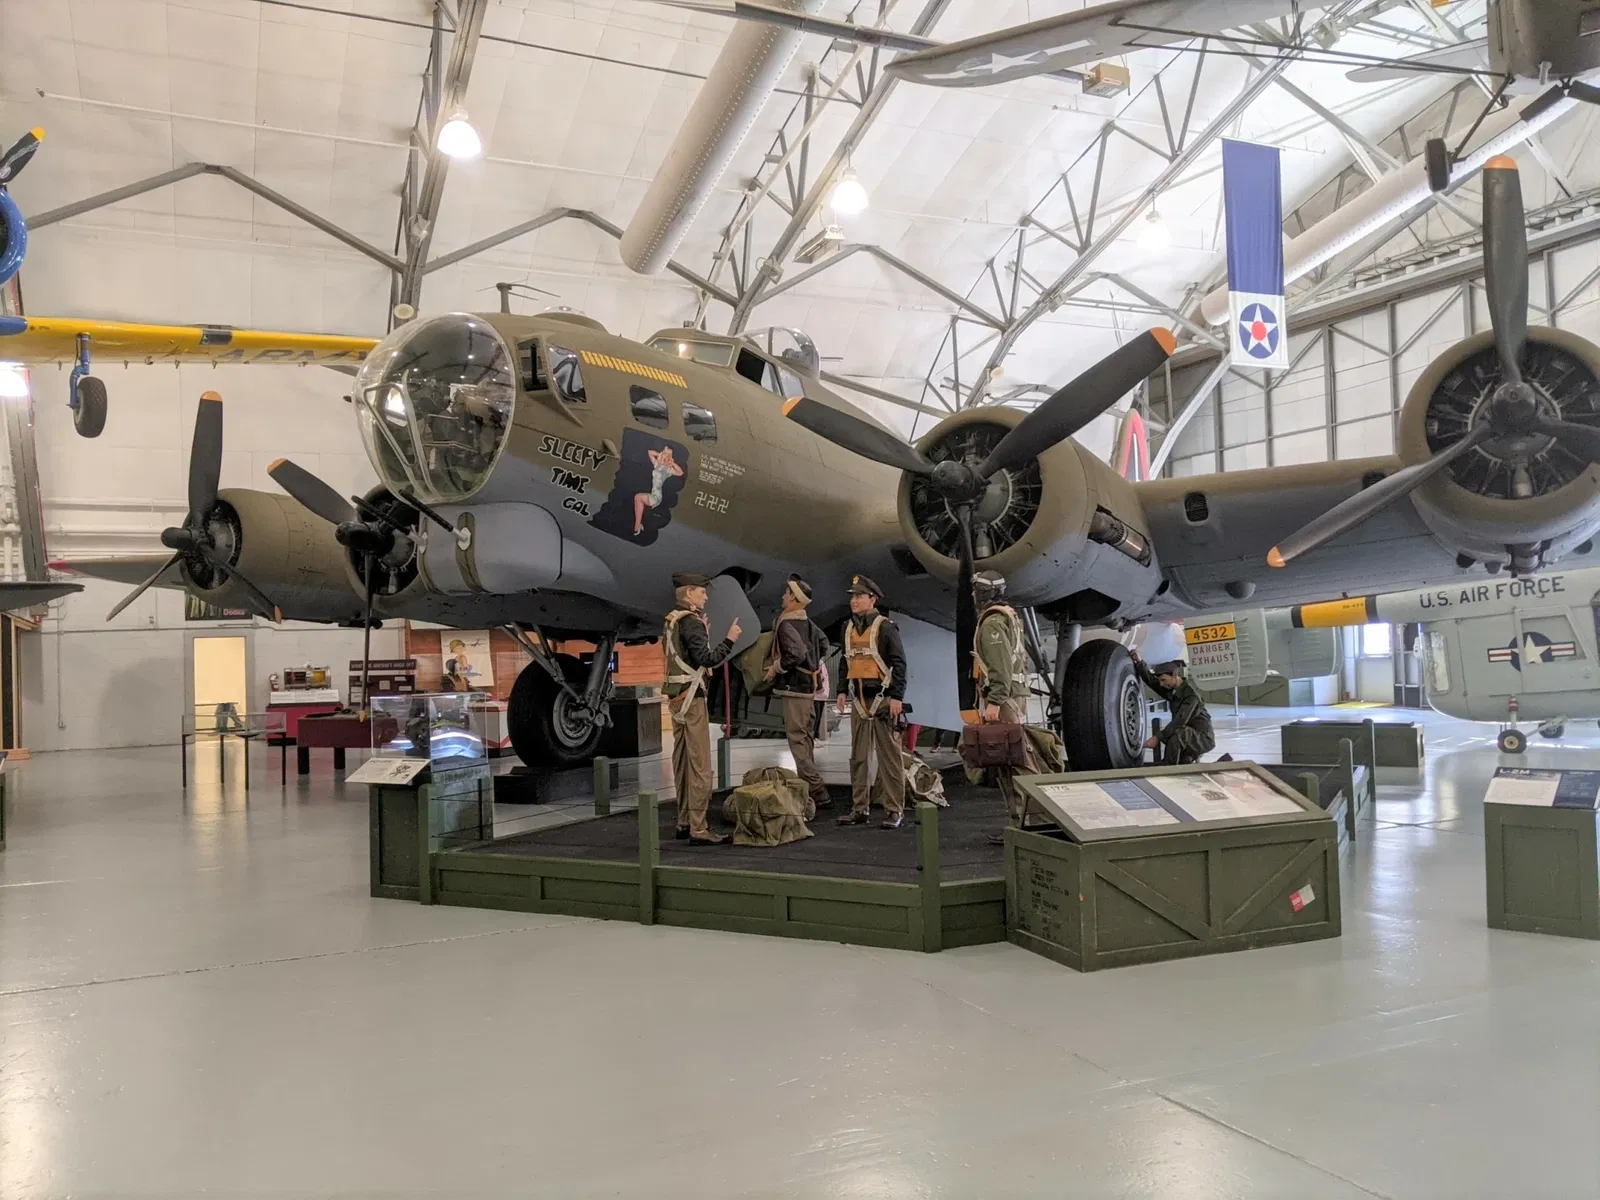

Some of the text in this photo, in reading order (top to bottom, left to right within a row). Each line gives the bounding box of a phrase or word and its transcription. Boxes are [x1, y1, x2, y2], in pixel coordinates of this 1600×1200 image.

[538, 435, 607, 471] SLEEPY
[551, 466, 590, 495] TIME
[562, 496, 590, 518] GAL
[1420, 576, 1566, 609] U.S. AIR FORCE
[1193, 626, 1228, 641] 4532
[1191, 652, 1236, 666] EXHAUST
[1192, 642, 1231, 655] DANGER
